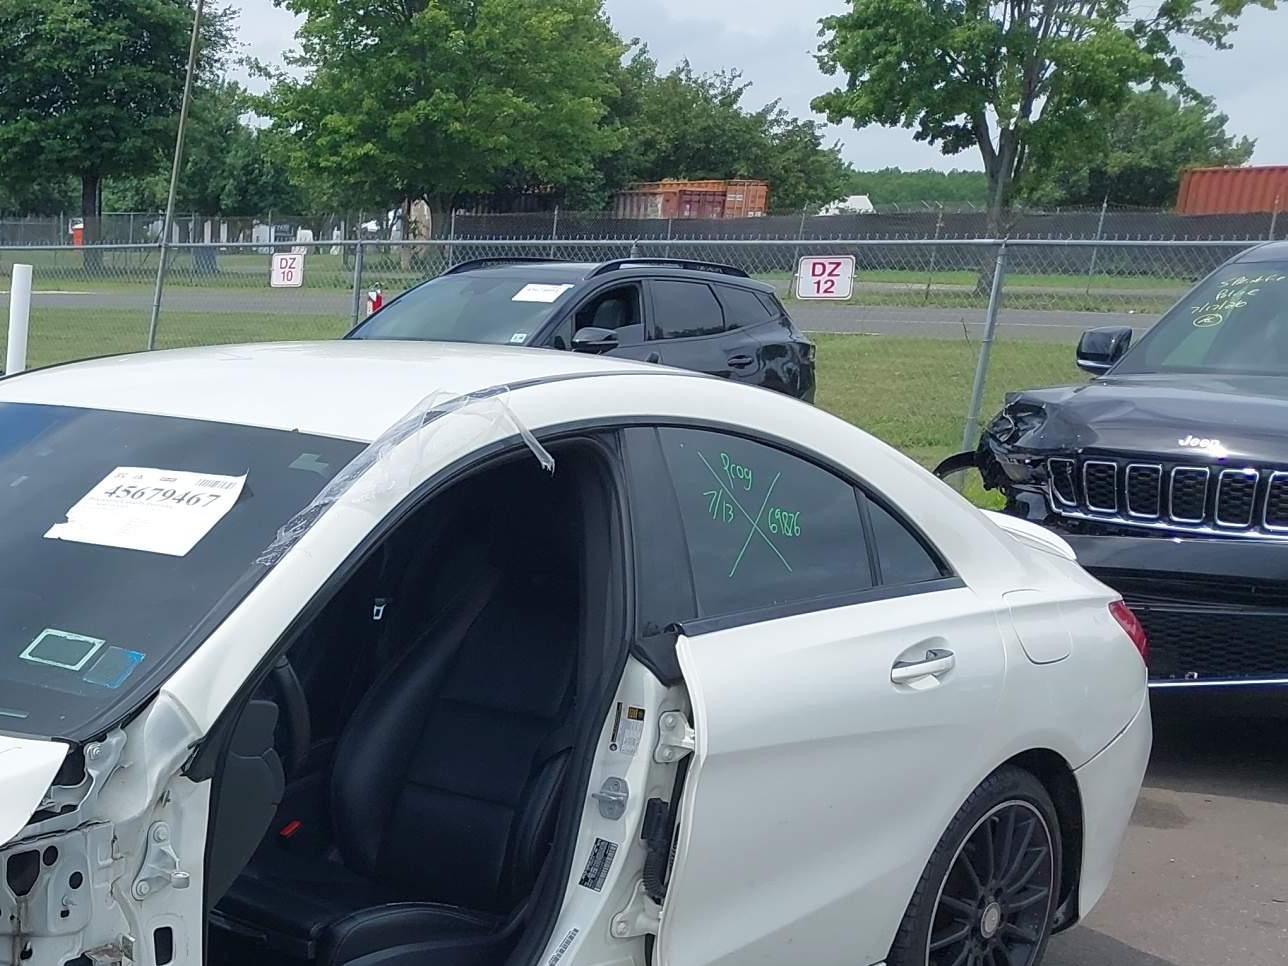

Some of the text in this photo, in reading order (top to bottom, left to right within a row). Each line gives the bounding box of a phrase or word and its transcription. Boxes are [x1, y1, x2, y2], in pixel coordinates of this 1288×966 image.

[280, 257, 297, 270] DZ
[811, 261, 842, 277] DZ
[281, 270, 294, 282] 10
[813, 279, 836, 294] 12
[1178, 435, 1221, 451] Jeep
[104, 484, 223, 508] 45679467
[703, 488, 734, 523] 7/13
